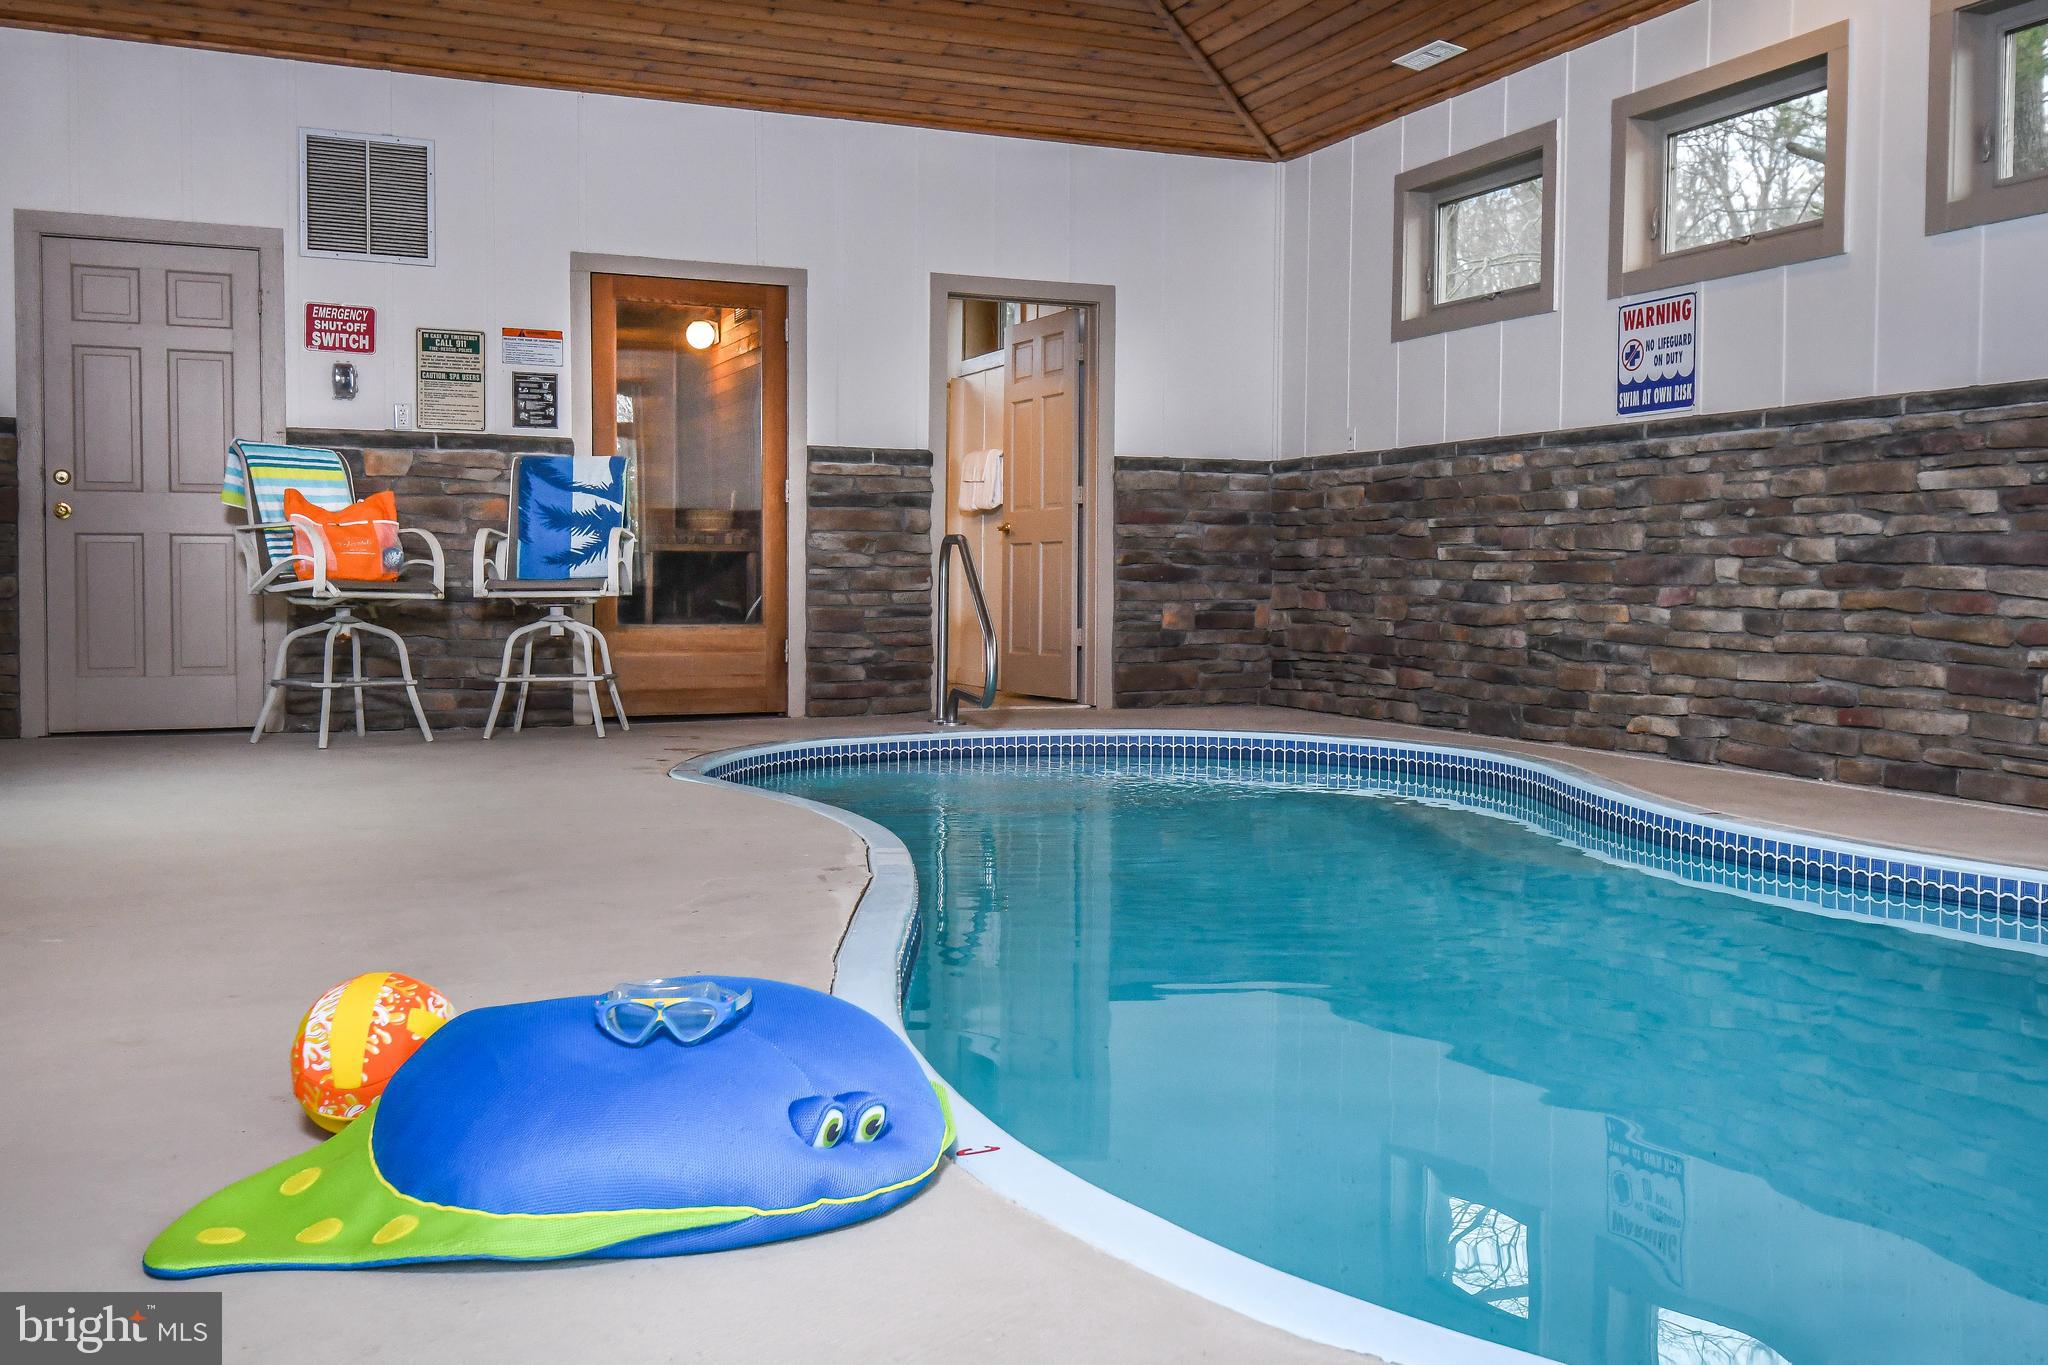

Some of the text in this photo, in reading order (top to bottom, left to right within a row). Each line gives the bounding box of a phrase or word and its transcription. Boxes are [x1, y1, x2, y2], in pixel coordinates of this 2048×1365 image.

[312, 306, 368, 321] EMERGENCY
[1624, 299, 1691, 331] WARNING
[314, 320, 367, 332] SHUT-OFF
[312, 332, 369, 349] SWITCH
[435, 339, 453, 347] CALL
[1646, 333, 1692, 352] NO LIFEGUARD
[1654, 350, 1683, 367] ON DUTY
[1620, 383, 1692, 408] SWIM AT OWN RISK
